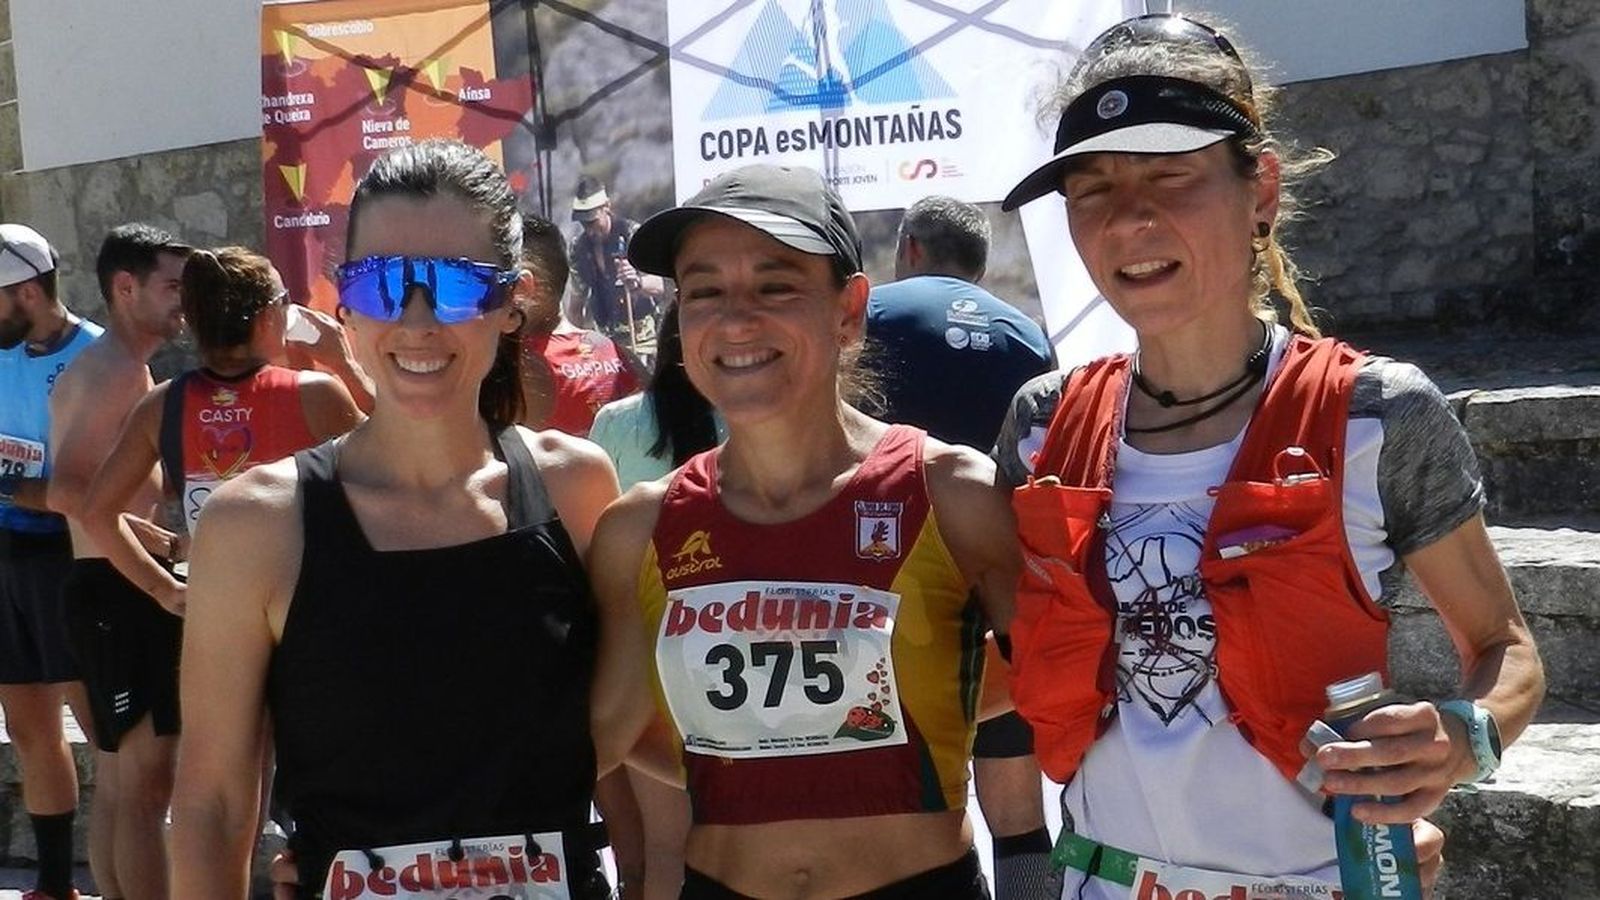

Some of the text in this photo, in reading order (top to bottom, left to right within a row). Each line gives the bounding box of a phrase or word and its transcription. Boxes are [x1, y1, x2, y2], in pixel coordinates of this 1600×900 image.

[262, 91, 314, 108] handrexa
[458, 86, 491, 101] Aínsa
[274, 108, 311, 124] Queixa
[362, 119, 410, 134] Nieva de
[700, 104, 963, 162] COPA esMONTAÑAS
[363, 134, 412, 150] Cameros
[274, 211, 330, 228] Candelario
[200, 407, 253, 423] CASTY
[665, 591, 889, 637] bedunia
[705, 640, 844, 711] 375
[331, 846, 561, 900] bedunia
